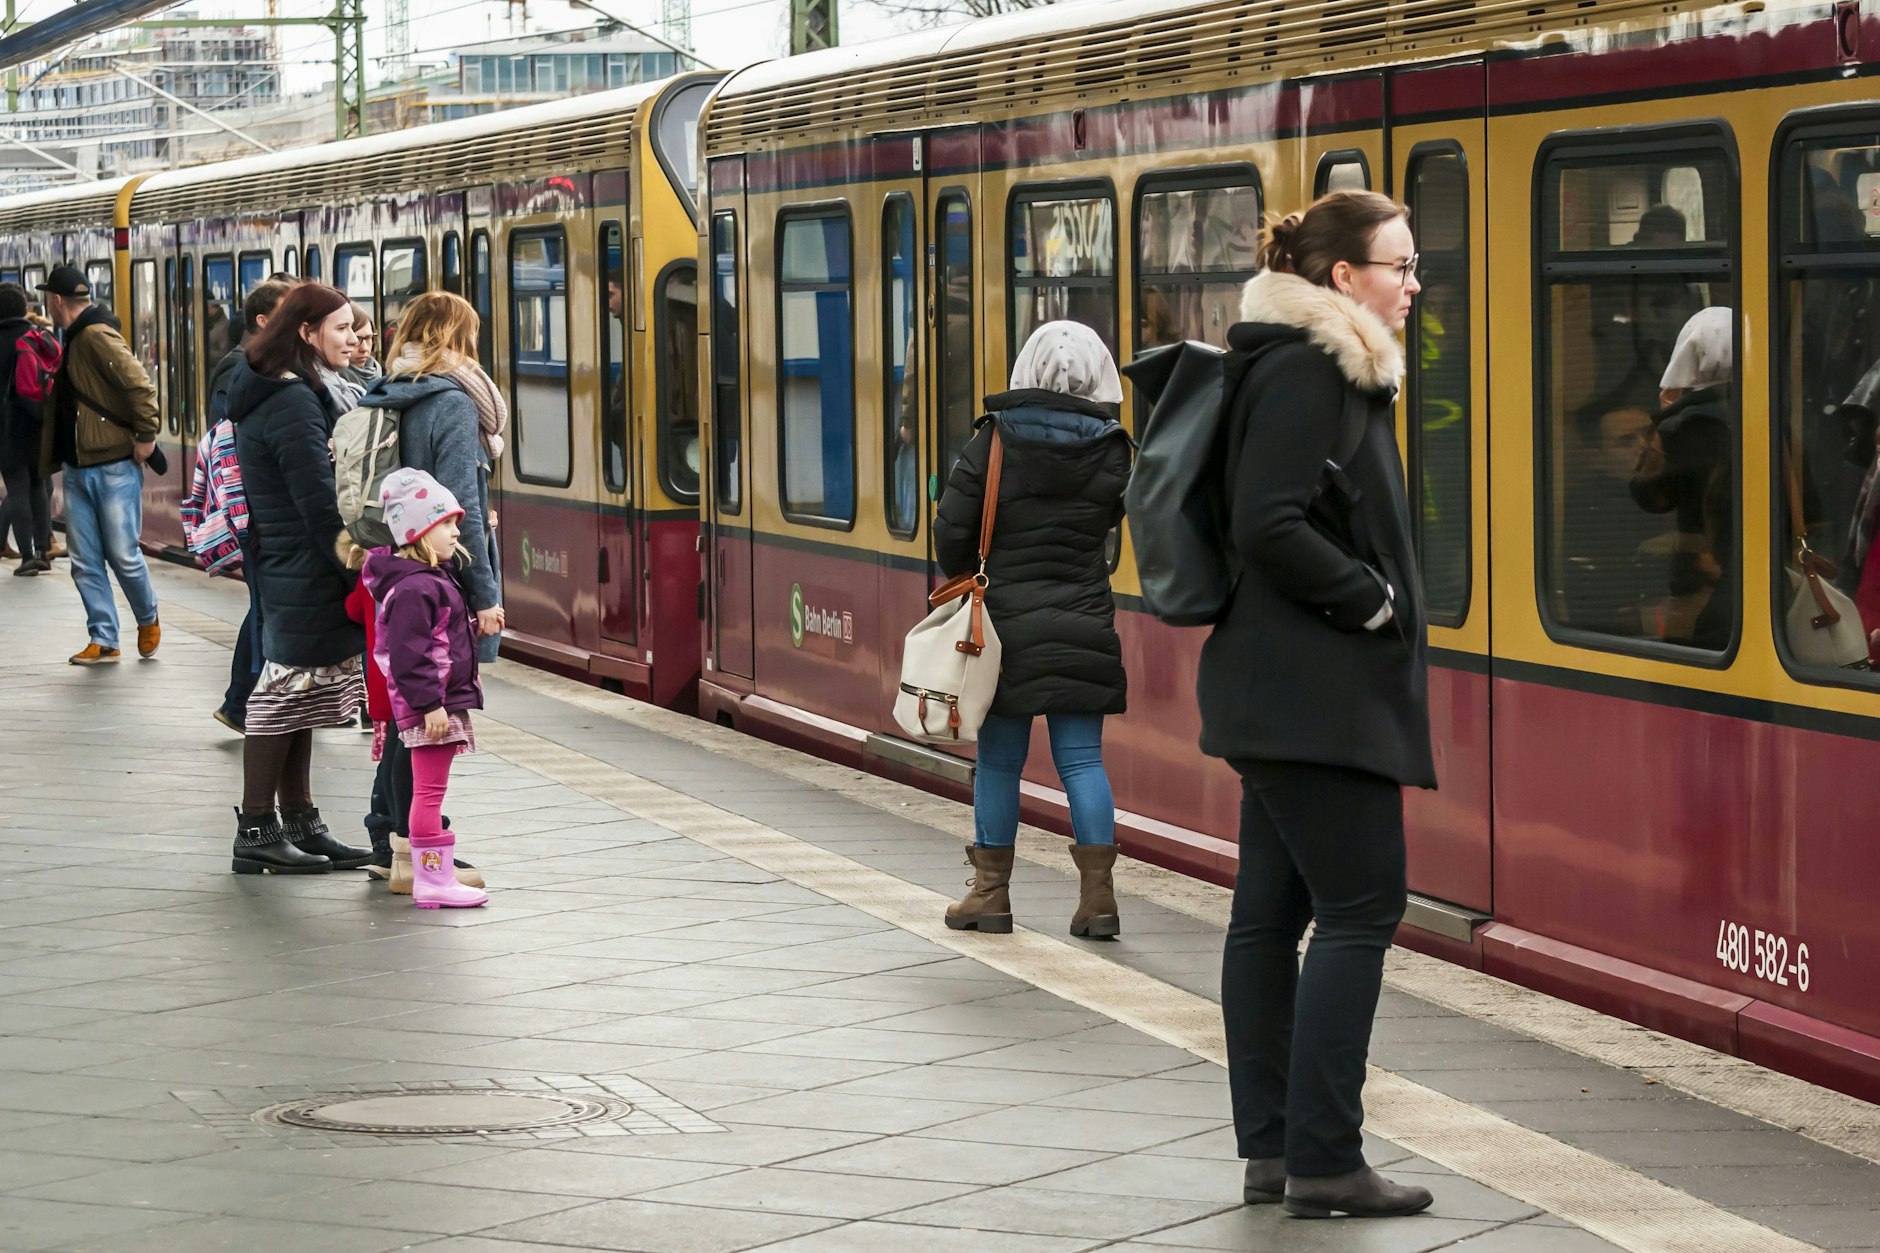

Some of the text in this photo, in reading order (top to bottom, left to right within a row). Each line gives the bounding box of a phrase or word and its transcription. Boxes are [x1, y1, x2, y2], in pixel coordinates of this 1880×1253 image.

[522, 537, 530, 577] S
[532, 547, 544, 571] Bahn
[545, 549, 560, 574] Berlin
[792, 590, 802, 641] S
[804, 604, 821, 634] Bahn
[821, 608, 842, 639] Berlin
[1716, 919, 1810, 992] 480 582-6
